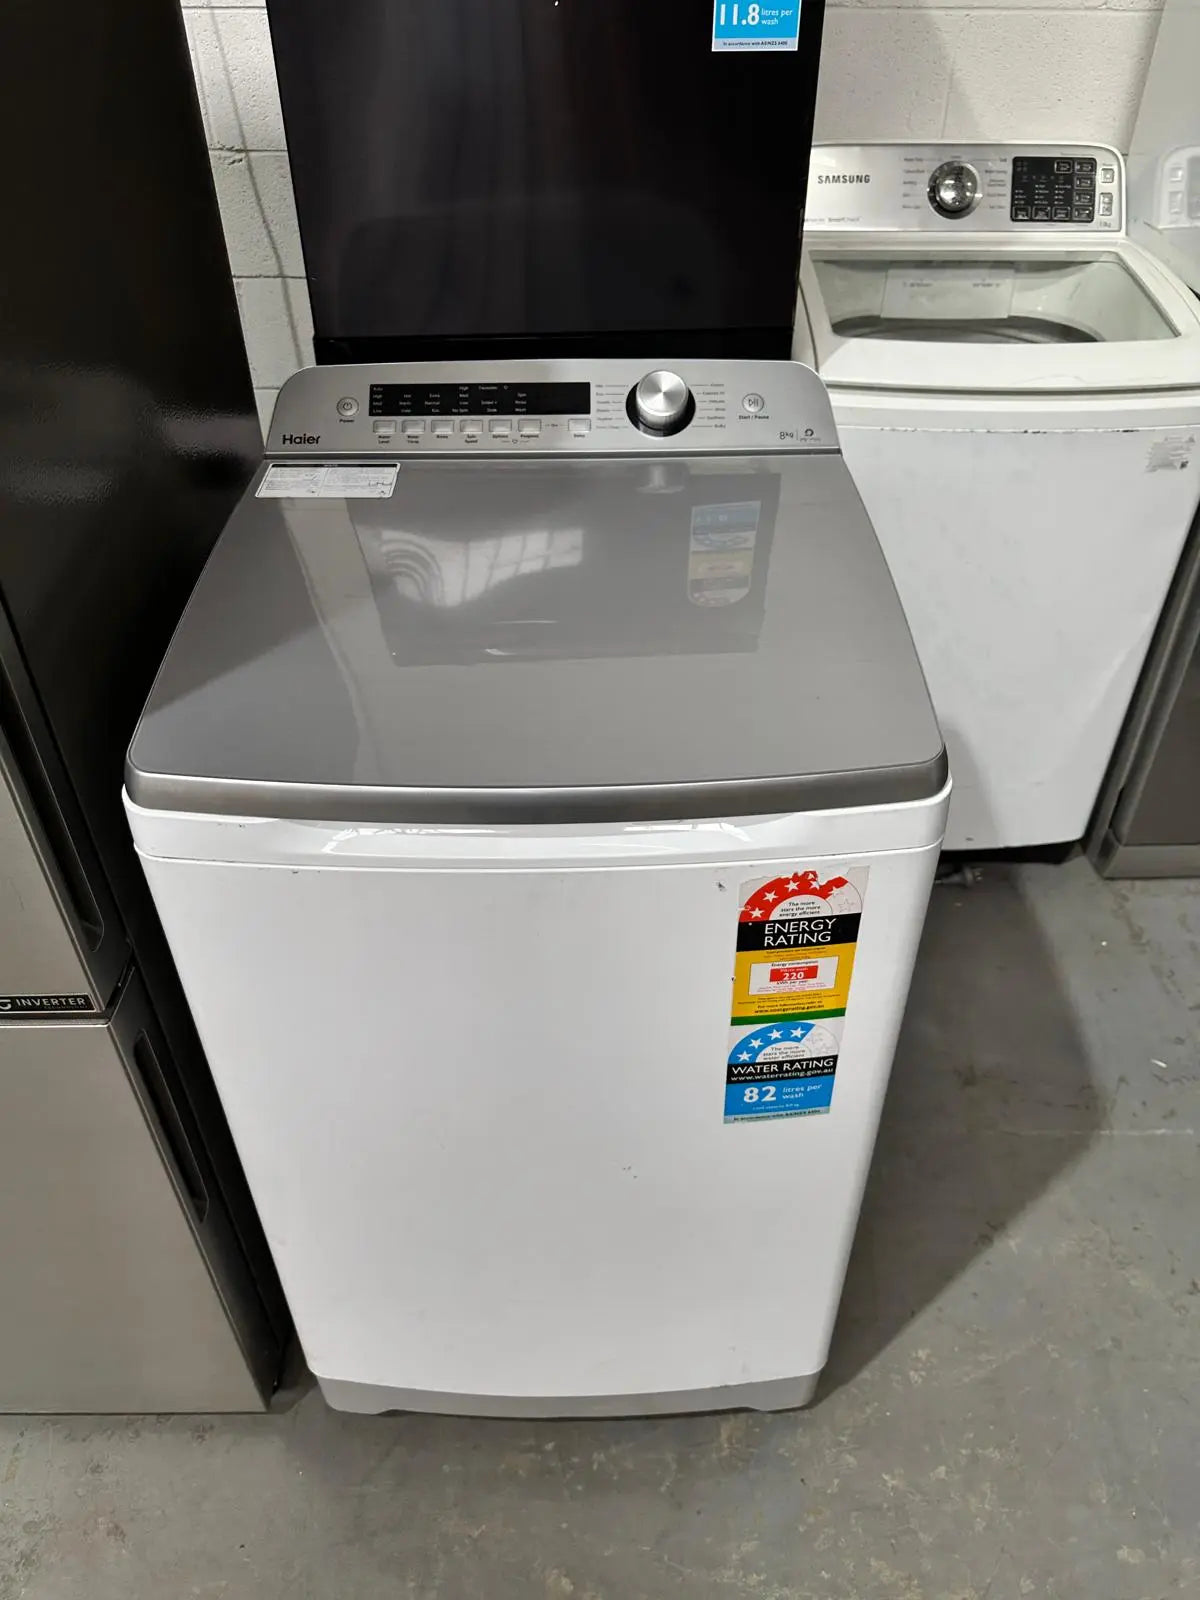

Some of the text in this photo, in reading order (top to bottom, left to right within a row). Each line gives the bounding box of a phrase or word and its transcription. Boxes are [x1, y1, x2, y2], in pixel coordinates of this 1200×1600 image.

[720, 3, 760, 26] 11.8
[761, 8, 793, 18] litres per
[817, 174, 871, 184] SAMSUNG
[281, 433, 321, 446] Haier
[765, 918, 836, 934] ENERGY
[764, 932, 831, 946] RATING
[783, 971, 805, 980] 220
[15, 997, 86, 1006] INVERTER
[731, 1058, 834, 1075] WATER RATING
[730, 1067, 834, 1081] www.waterrating.gov.au
[743, 1085, 777, 1103] 82
[806, 1084, 822, 1092] per
